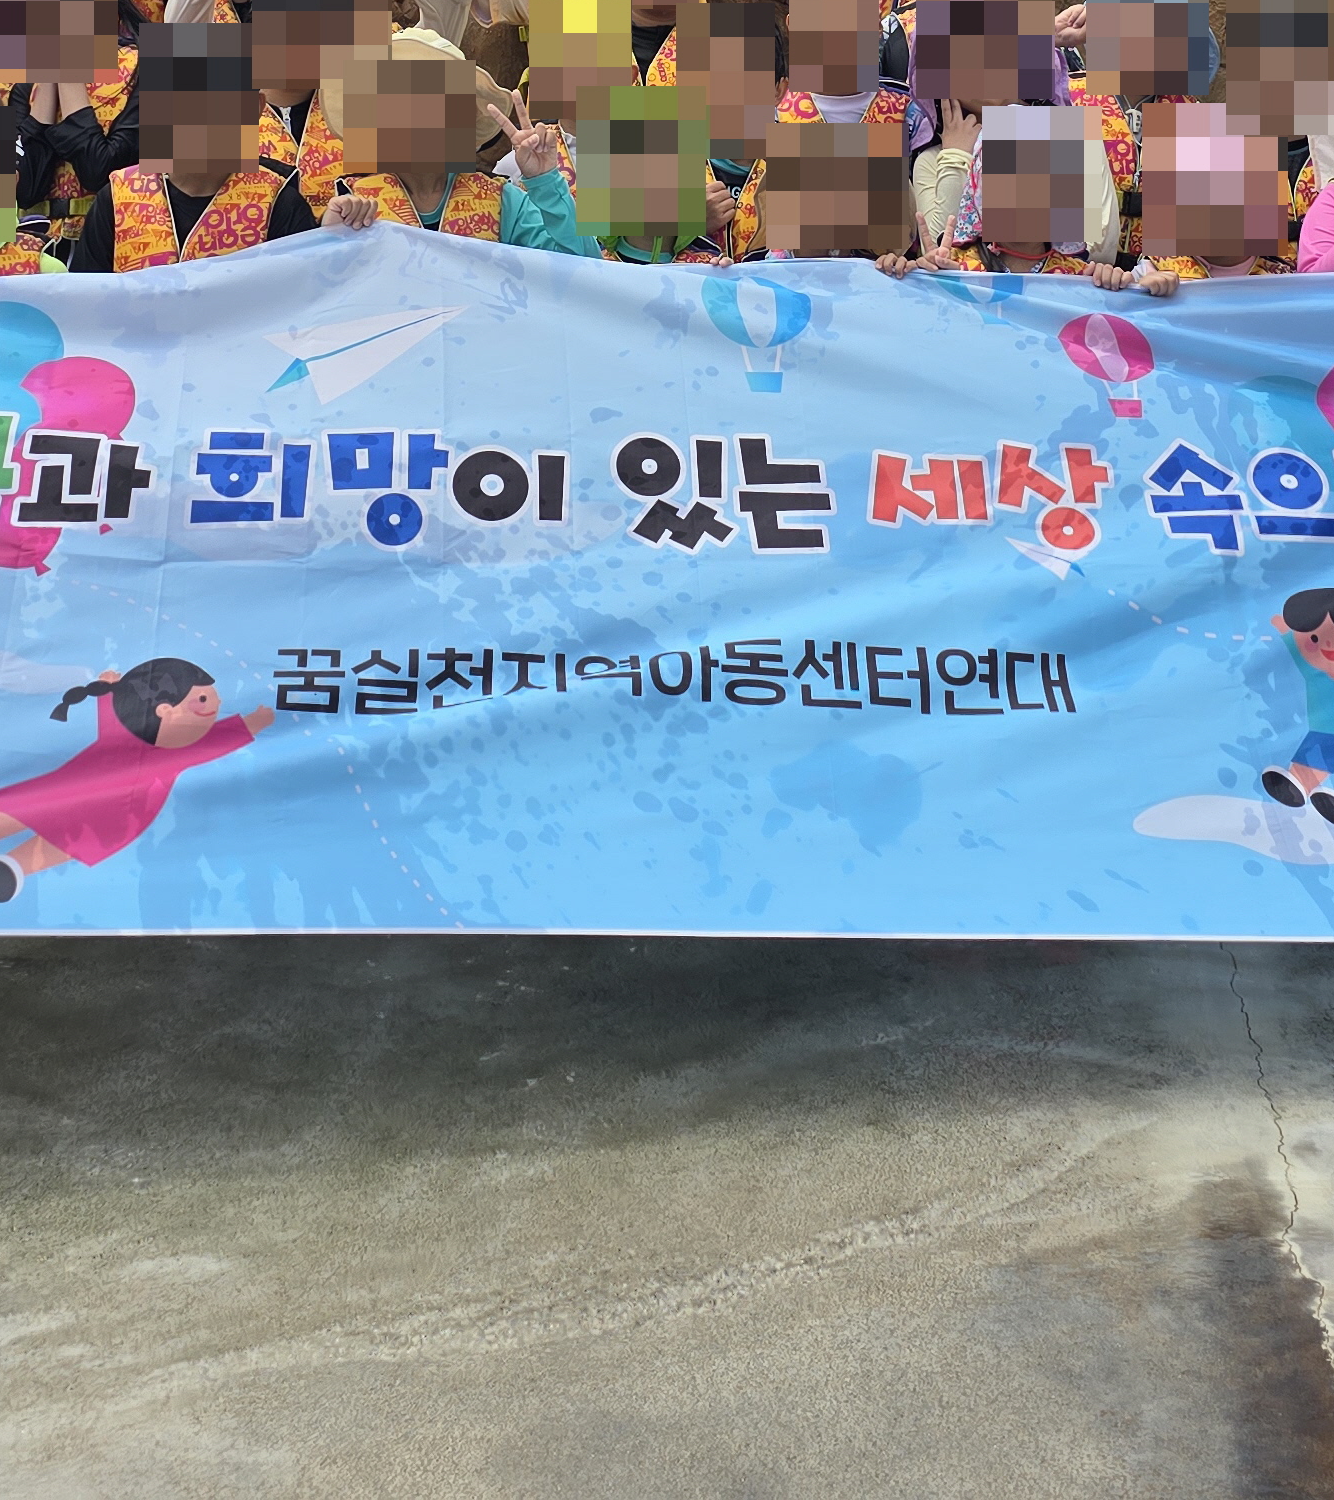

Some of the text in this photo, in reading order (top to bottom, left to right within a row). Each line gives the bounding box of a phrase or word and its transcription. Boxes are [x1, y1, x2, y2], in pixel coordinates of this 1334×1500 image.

[189, 430, 567, 548] 희망이
[614, 435, 833, 552] 있는
[871, 442, 1111, 551] 세상
[273, 639, 1077, 714] 꿈실천지역아동센터연대
